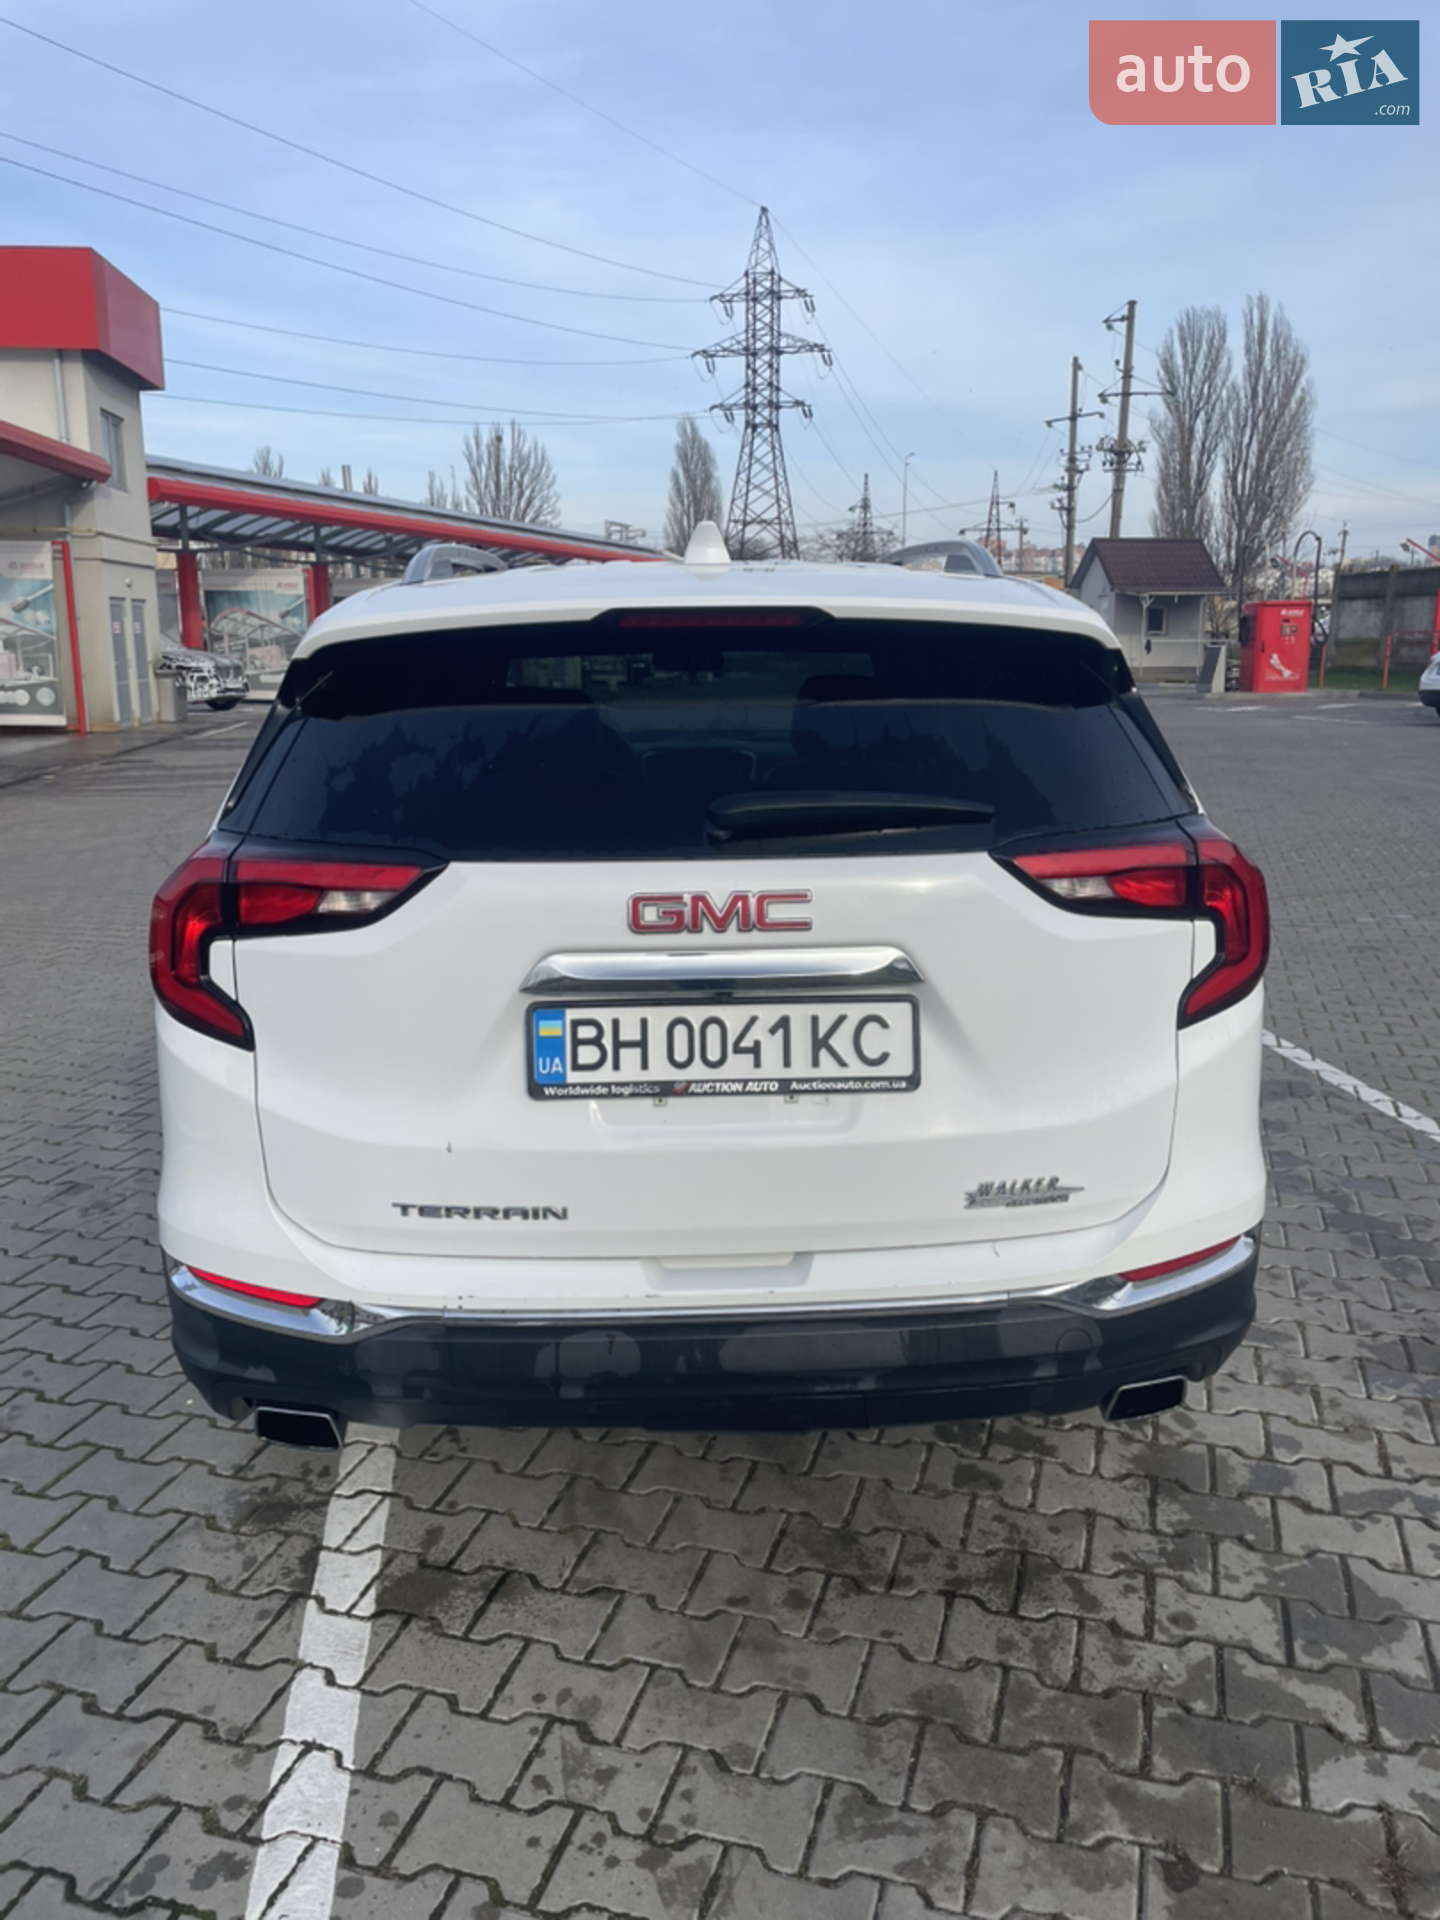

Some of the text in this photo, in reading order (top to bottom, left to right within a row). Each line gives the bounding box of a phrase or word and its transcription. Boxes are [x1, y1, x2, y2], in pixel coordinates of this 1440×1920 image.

[628, 889, 812, 934] GMC
[570, 1013, 891, 1073] BH 0041 KC
[538, 1056, 564, 1076] UA
[543, 1079, 907, 1097] Worldwide logistics AUCTION AUTO Auctionauto.com.ua
[391, 1202, 569, 1221] TERRAIN
